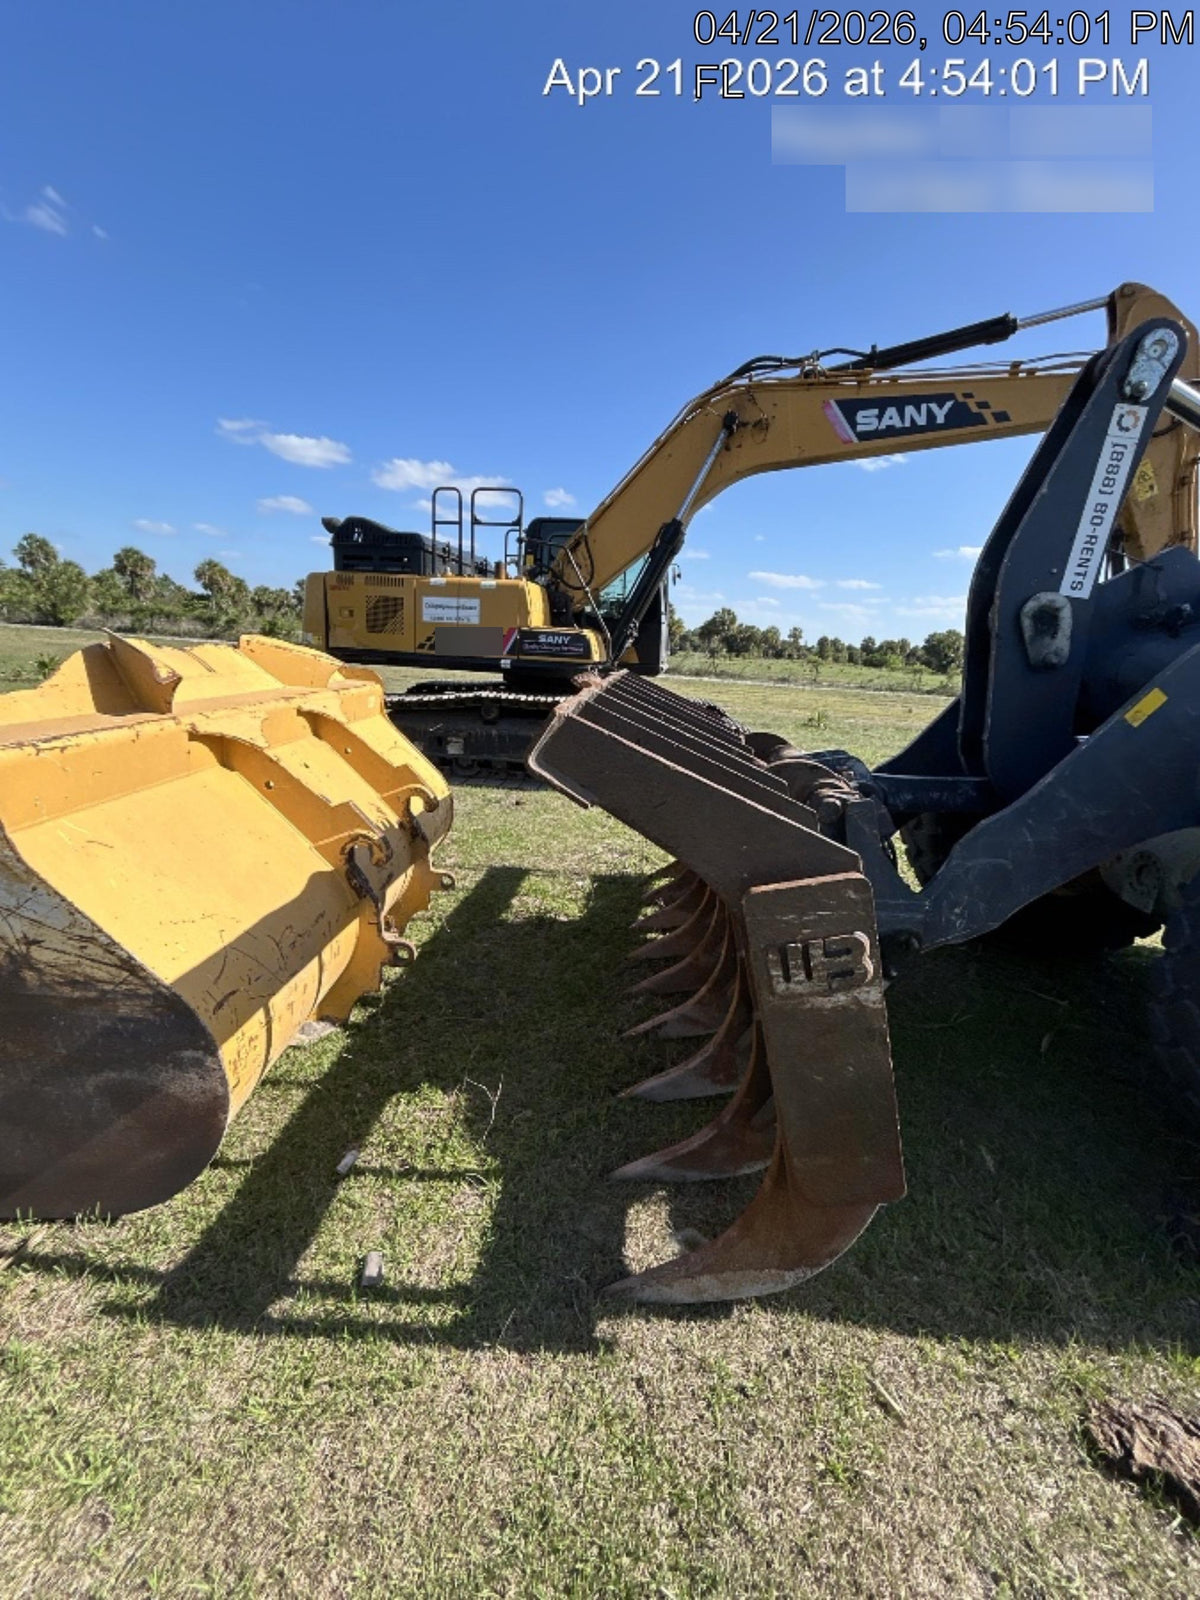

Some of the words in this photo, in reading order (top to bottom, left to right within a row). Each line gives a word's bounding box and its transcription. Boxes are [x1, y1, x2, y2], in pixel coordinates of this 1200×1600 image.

[855, 399, 956, 433] SANY
[1070, 502, 1109, 592] 80-RENTS
[538, 633, 572, 645] SANY
